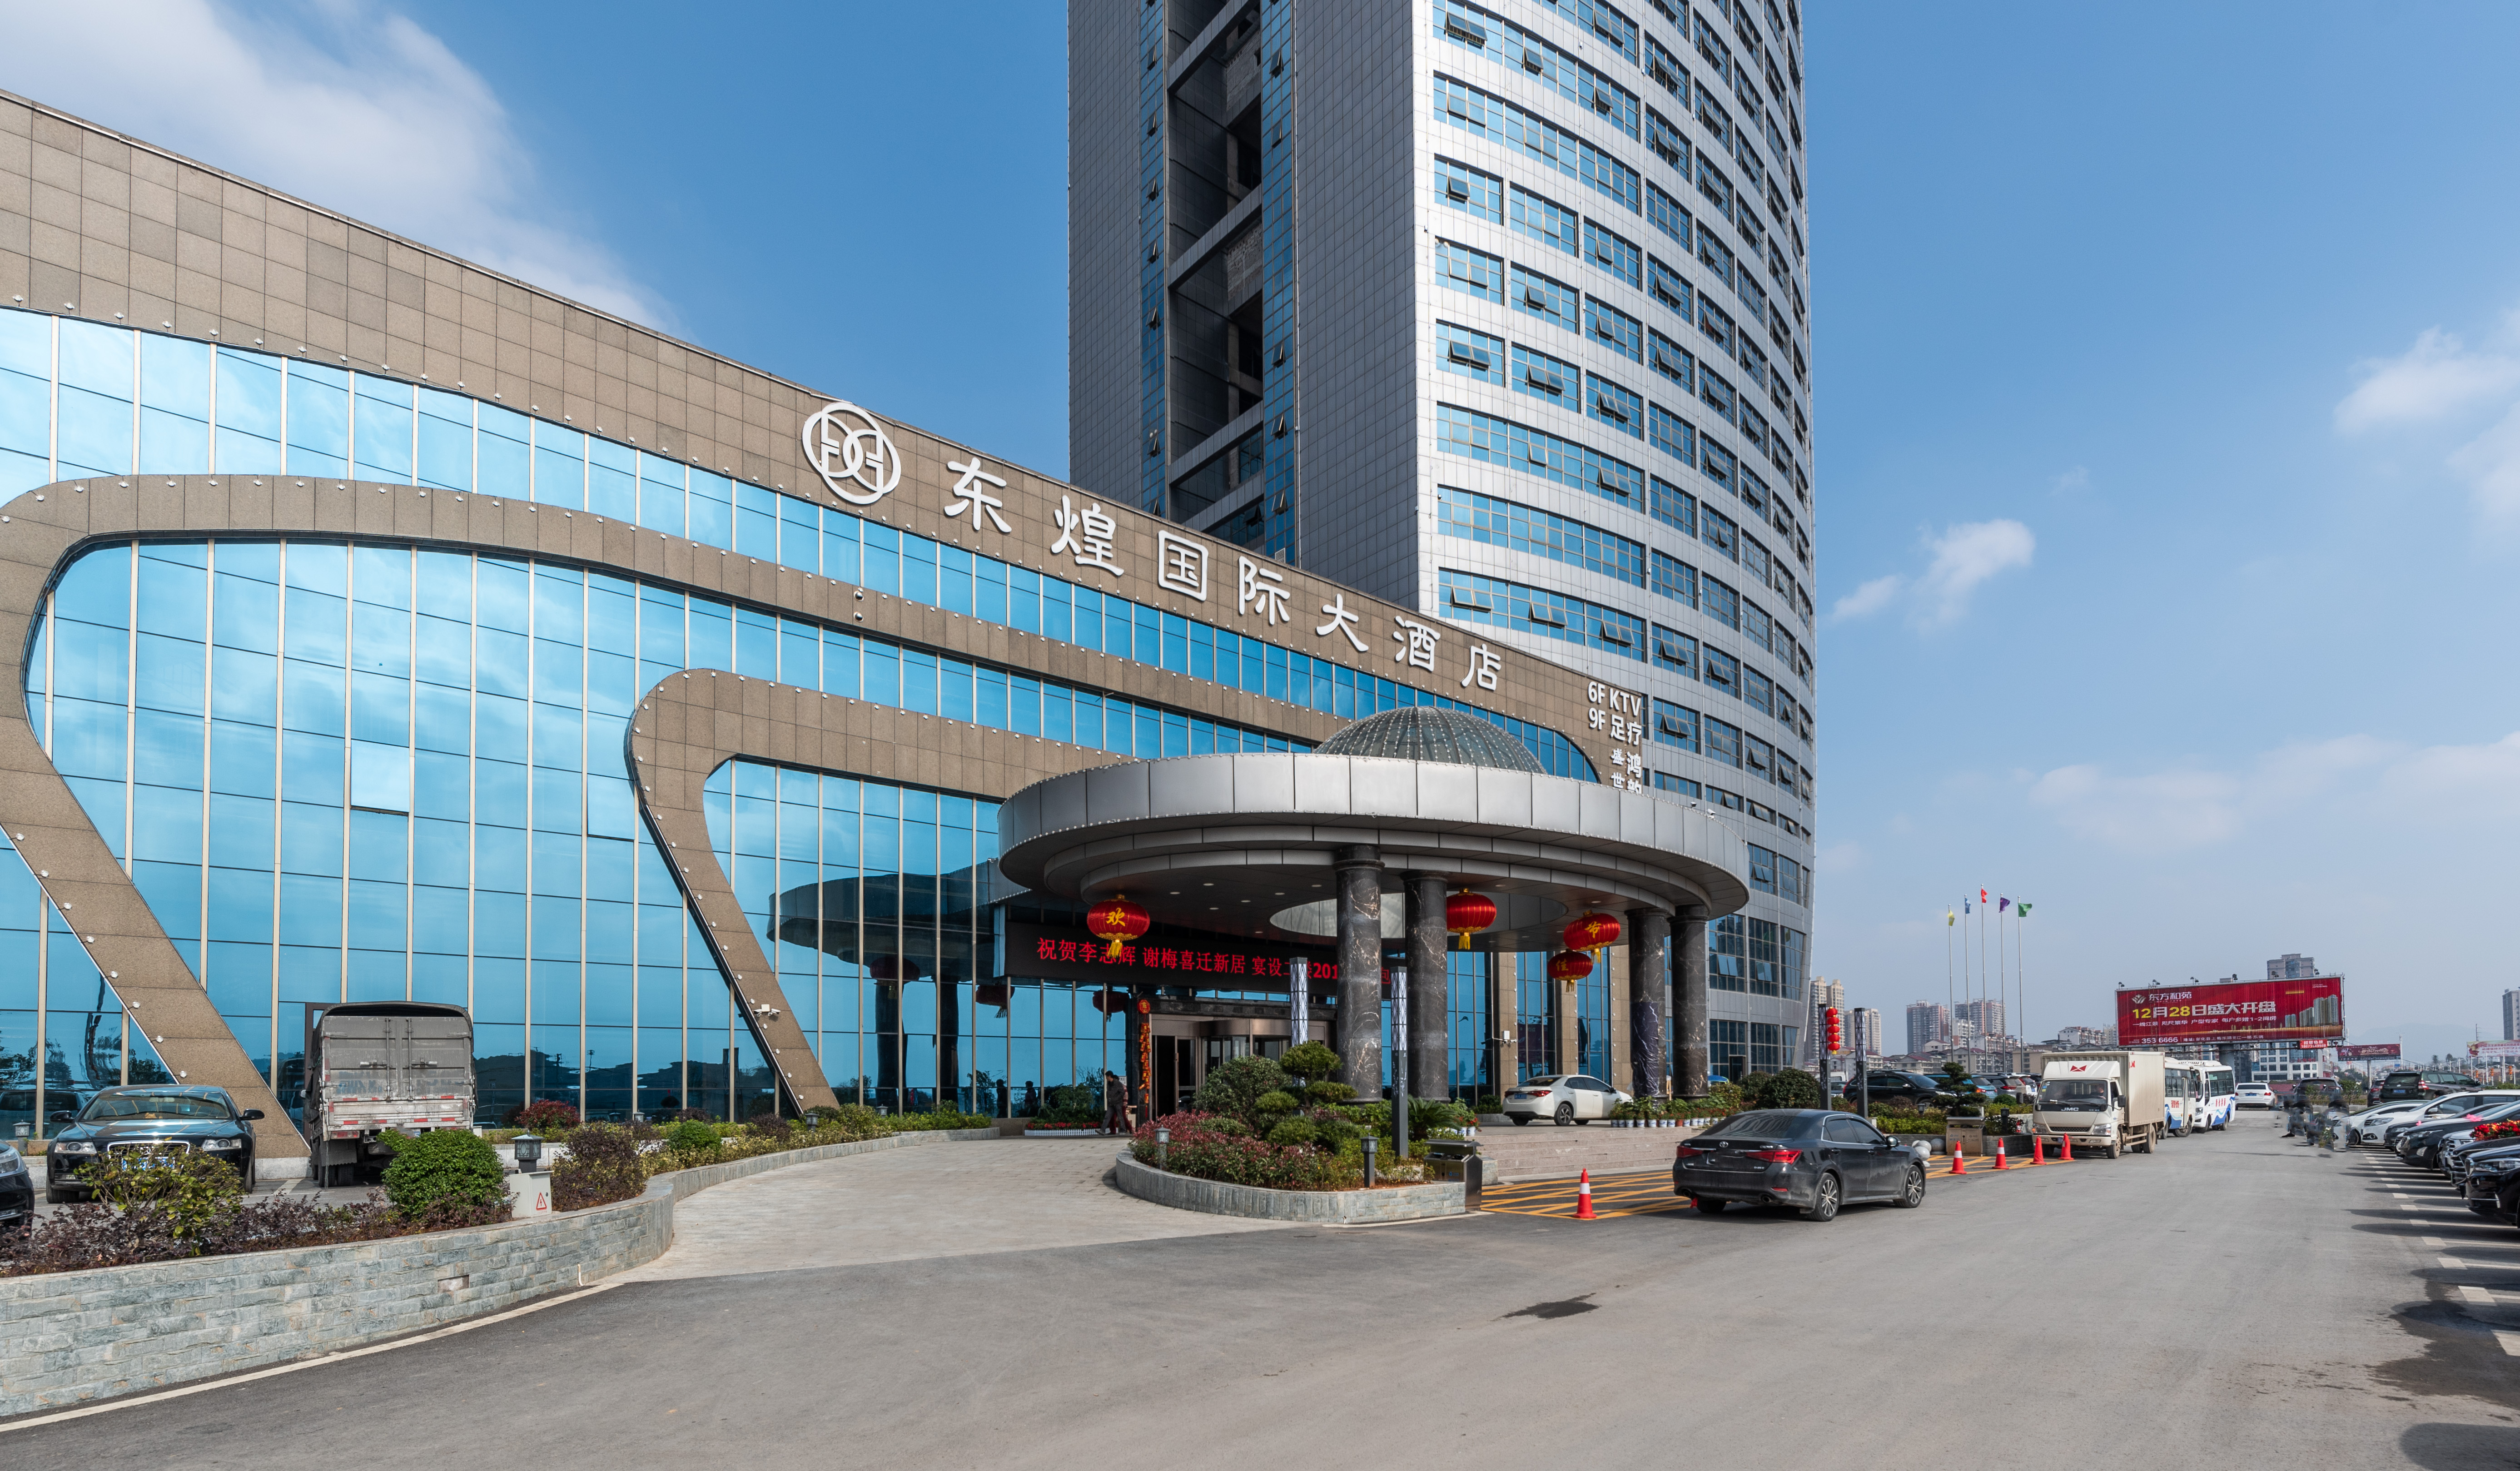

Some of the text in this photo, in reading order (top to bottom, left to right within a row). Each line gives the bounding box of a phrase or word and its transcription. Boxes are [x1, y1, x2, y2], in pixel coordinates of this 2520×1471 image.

[944, 457, 1501, 691] 东煌国际大酒店
[1588, 681, 1641, 716] 6F KTV
[1589, 707, 1642, 745] 9F 足疗
[1610, 748, 1625, 789] 盛世
[1106, 907, 1126, 927] 欢
[1037, 937, 1338, 980] 祝贺李志辉 谢梅喜迁新居 宴设201
[1556, 959, 1569, 972] 佳
[2132, 1001, 2276, 1019] 12月28日盛大开盘
[2148, 991, 2192, 1001] 东方和苑
